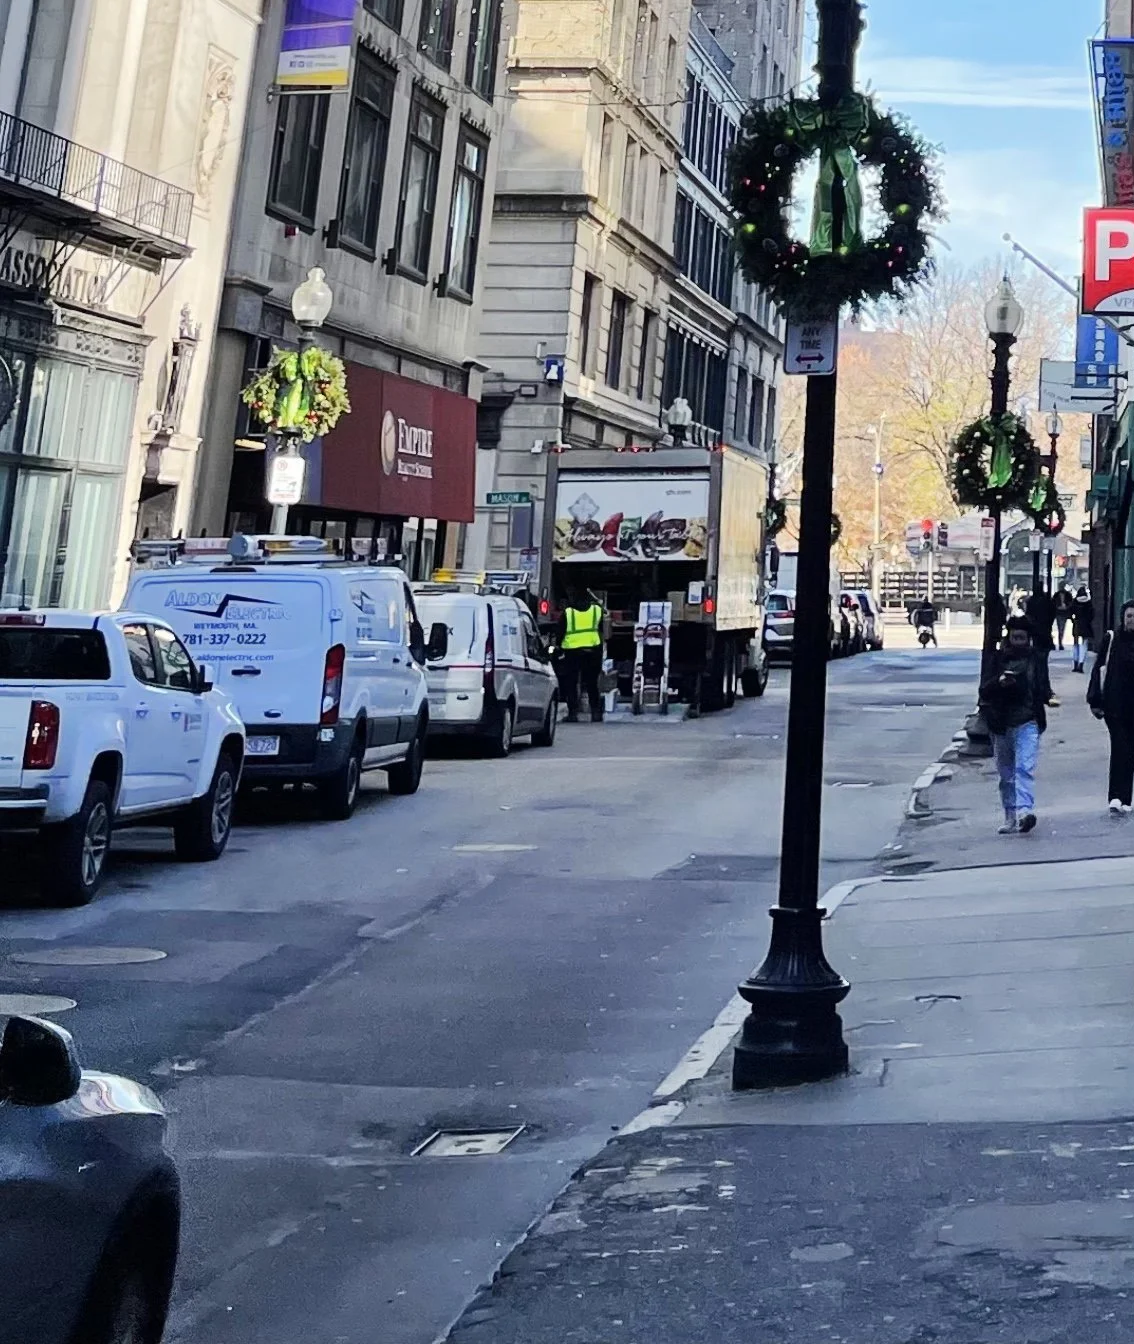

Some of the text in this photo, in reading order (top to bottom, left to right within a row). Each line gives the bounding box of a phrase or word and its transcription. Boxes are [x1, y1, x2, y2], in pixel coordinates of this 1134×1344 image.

[802, 327, 820, 336] ANY
[800, 339, 821, 350] TIME
[491, 493, 520, 504] MASON
[183, 633, 267, 645] 781-337-0222
